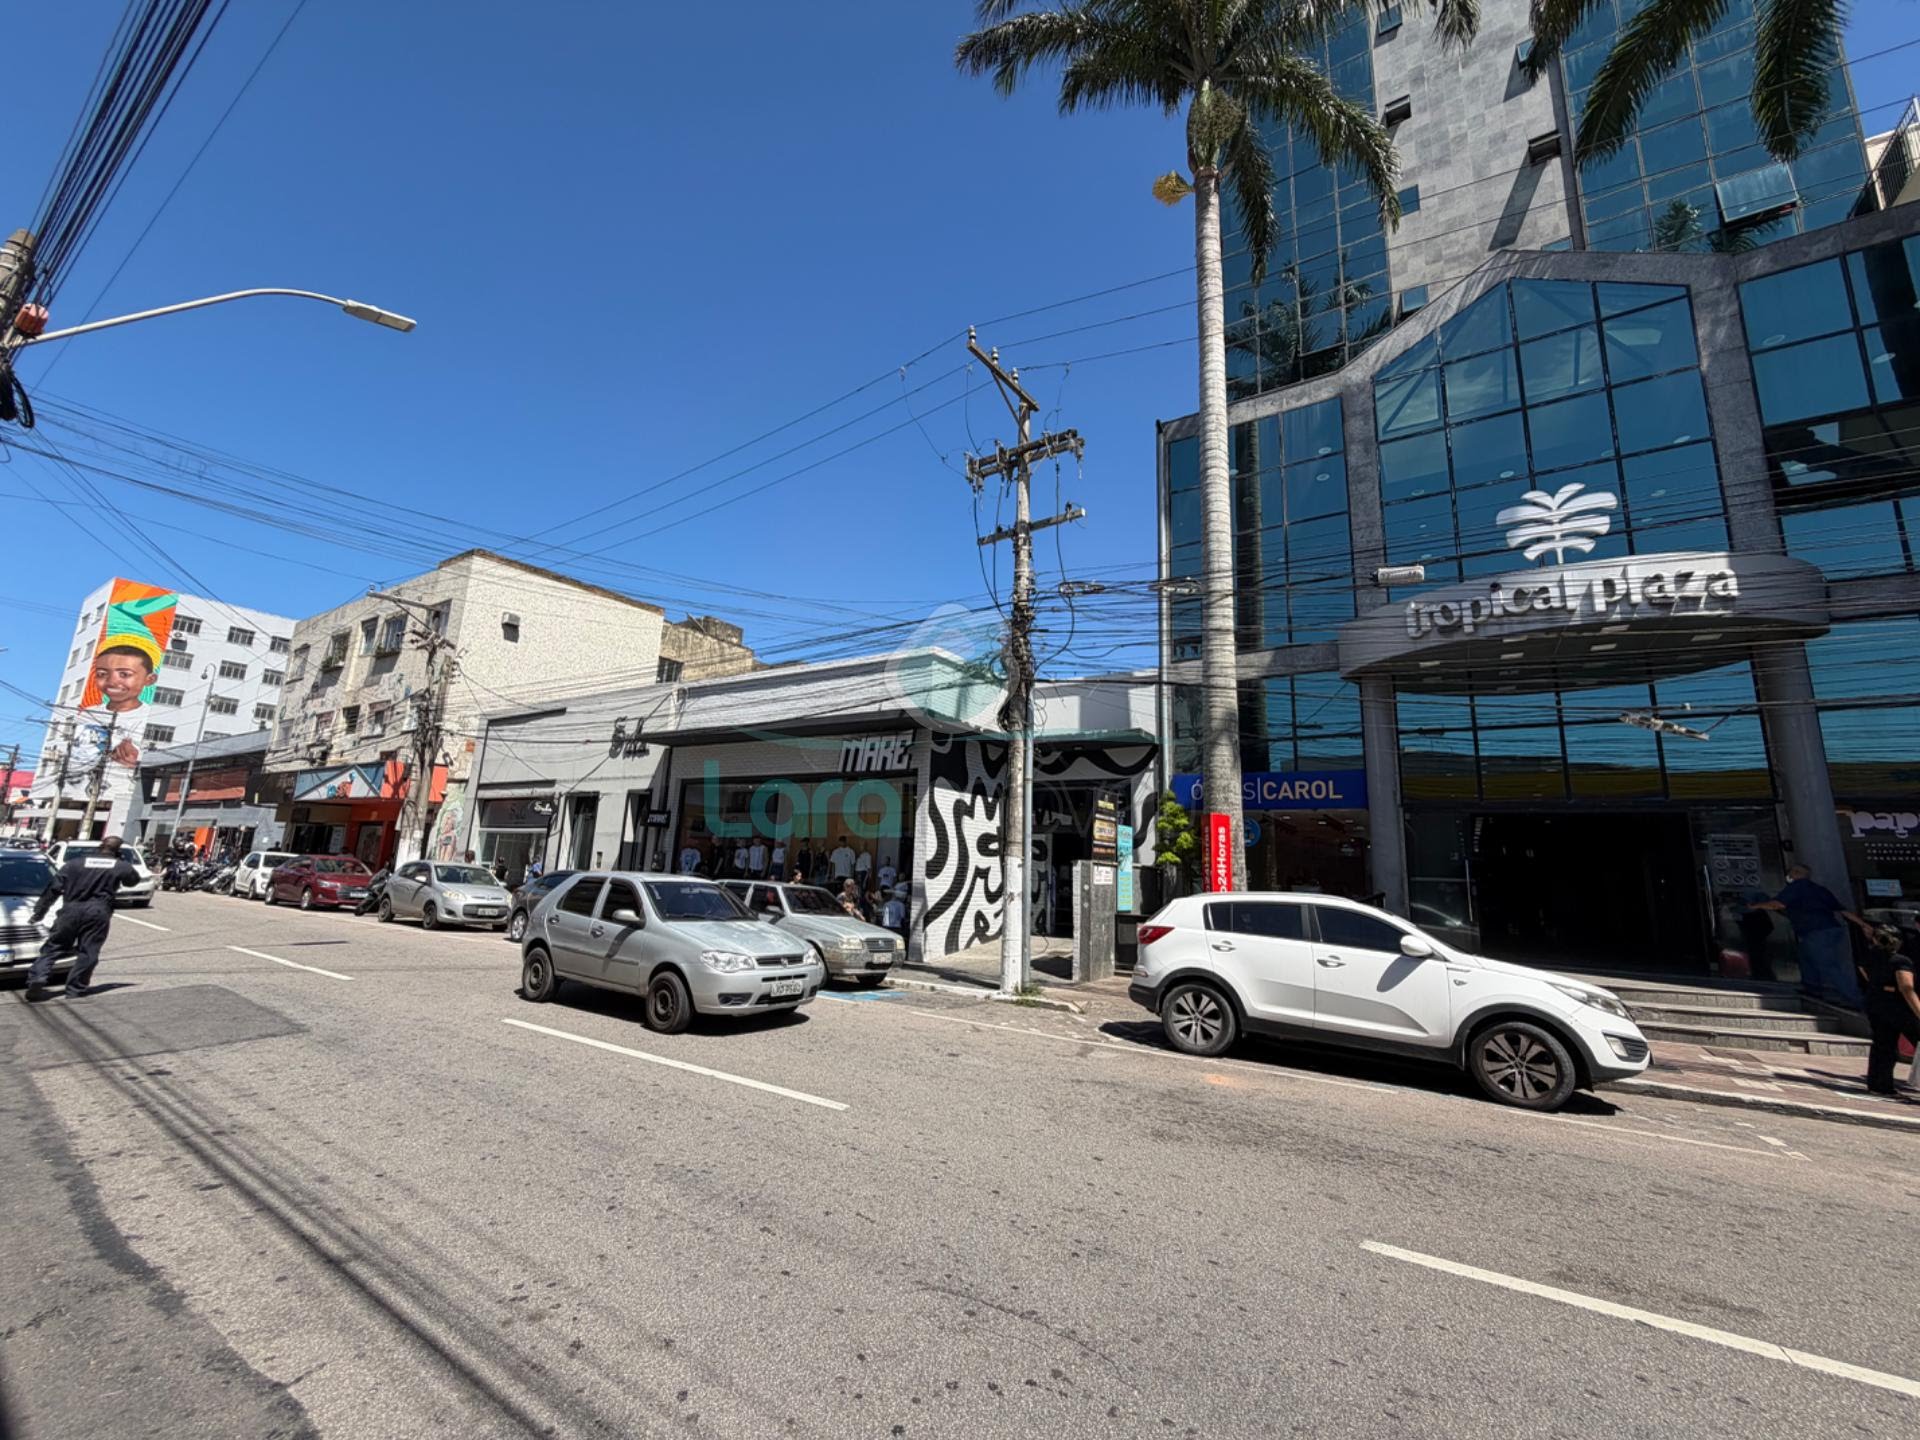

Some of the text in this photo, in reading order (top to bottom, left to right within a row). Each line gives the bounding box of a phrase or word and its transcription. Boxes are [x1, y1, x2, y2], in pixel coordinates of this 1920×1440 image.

[1405, 565, 1741, 638] tropical plaza
[1263, 780, 1343, 800] CAROL
[1846, 811, 1920, 838] pap
